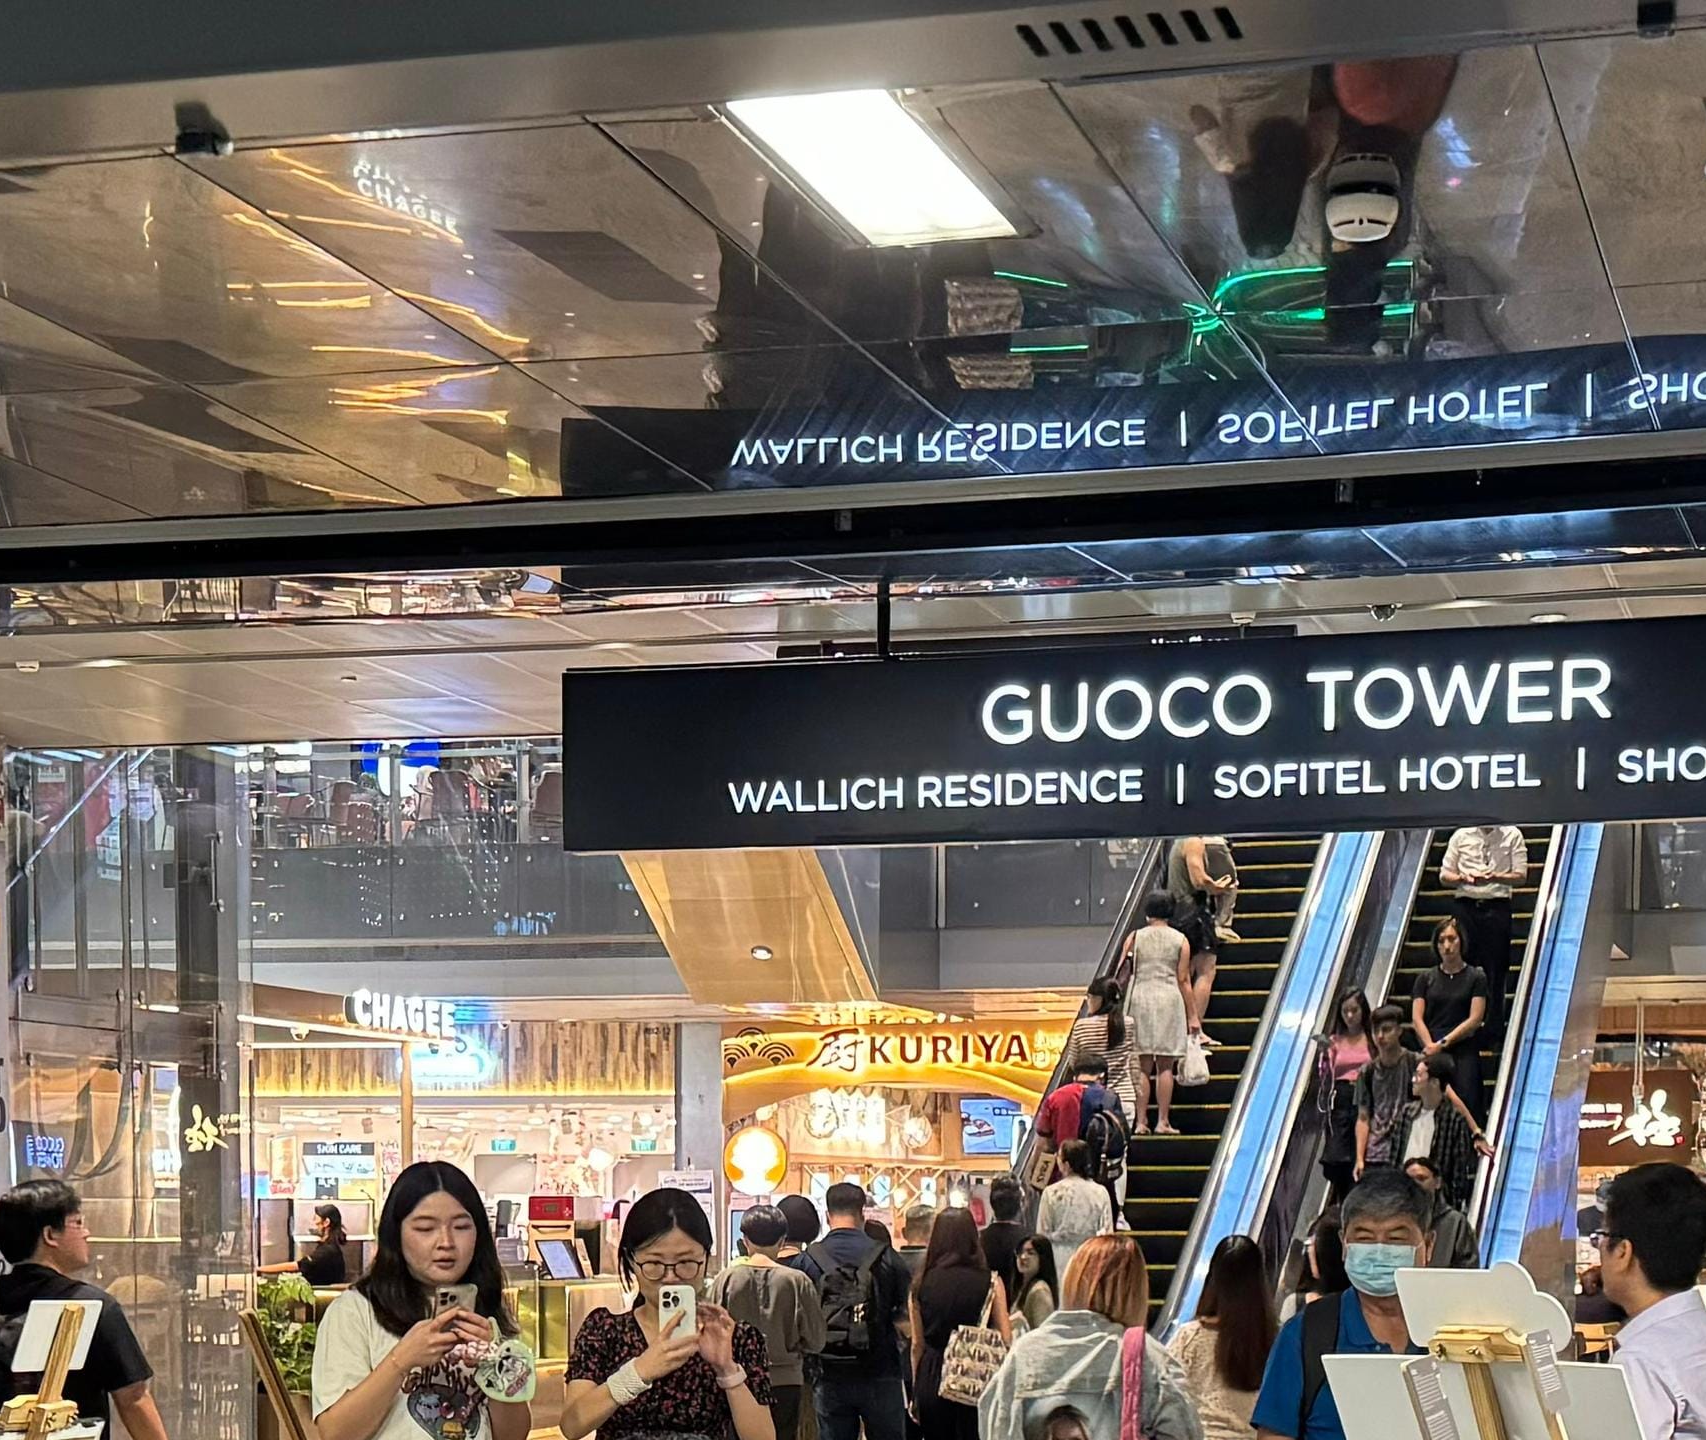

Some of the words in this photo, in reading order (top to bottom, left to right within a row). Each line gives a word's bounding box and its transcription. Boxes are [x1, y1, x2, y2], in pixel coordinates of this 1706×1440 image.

[981, 674, 1272, 746] GUOCO
[1305, 657, 1614, 732] TOWER
[728, 775, 904, 815] WALLICH
[918, 768, 1143, 809] RESIDENCE
[1213, 759, 1386, 799] SOFITEL
[1399, 753, 1542, 791] HOTEL
[353, 988, 456, 1040] CHAGEE
[869, 1034, 1029, 1065] KURIYA
